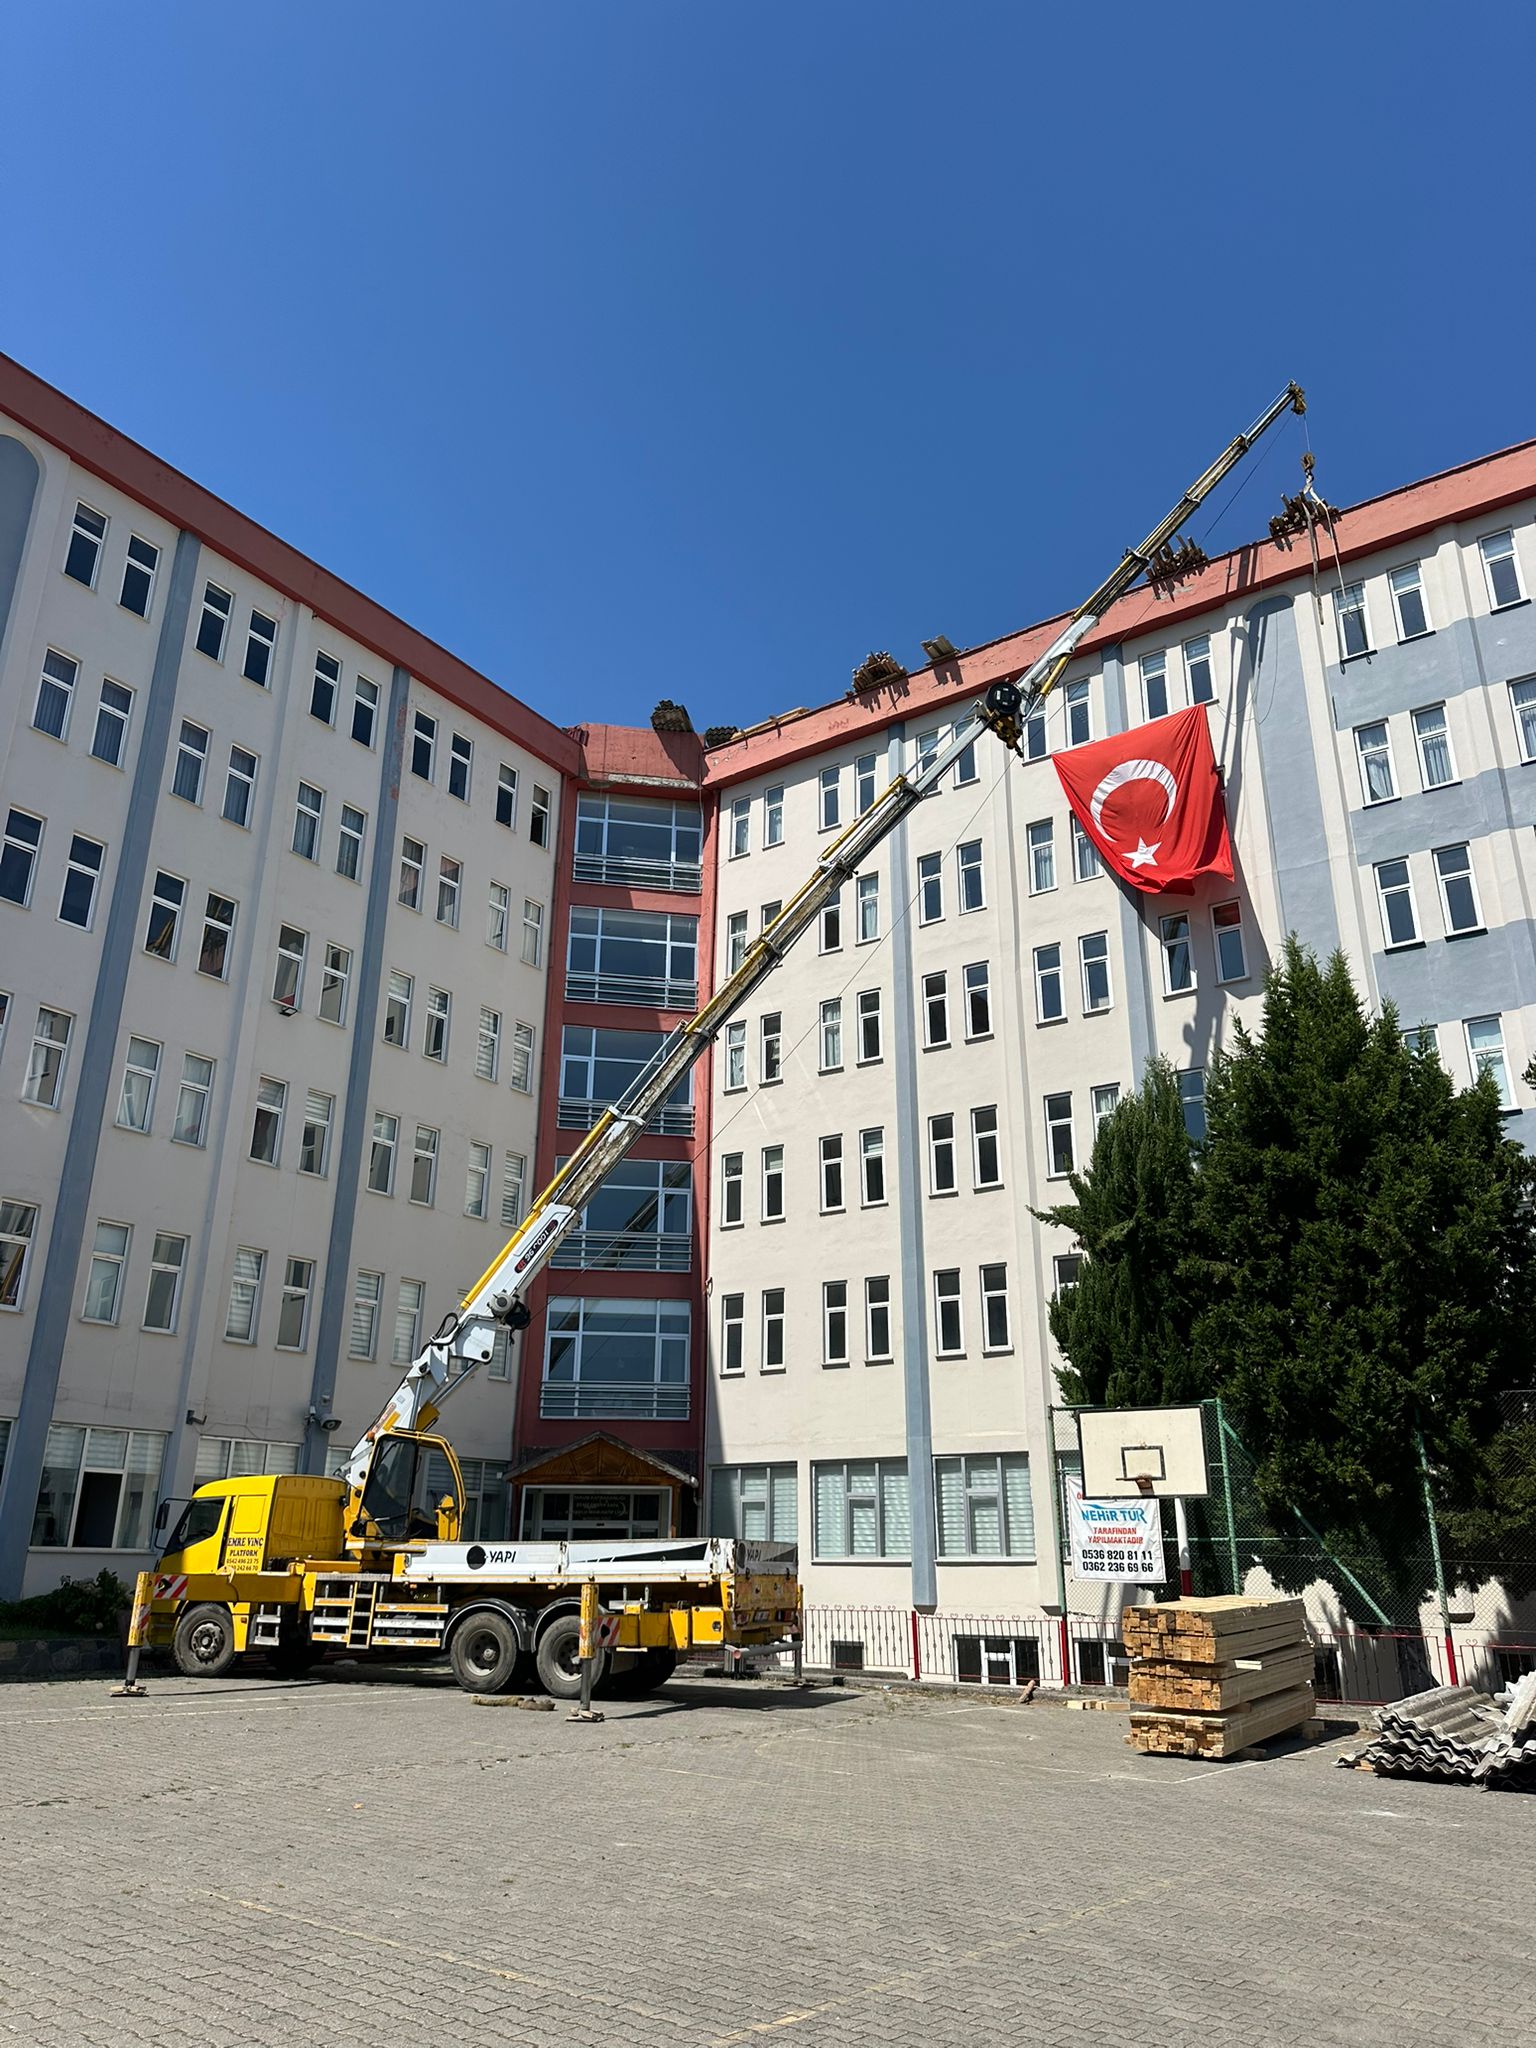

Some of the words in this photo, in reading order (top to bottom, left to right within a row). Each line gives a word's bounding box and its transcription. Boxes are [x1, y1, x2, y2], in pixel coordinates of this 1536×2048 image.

[1119, 1508, 1148, 1524] TUR
[1093, 1527, 1137, 1535] TARAFINDAN
[227, 1537, 246, 1547] EMRE
[1088, 1536, 1144, 1545] YAPILMAKTADIR
[489, 1550, 517, 1563] YAPI
[747, 1549, 762, 1561] YAPI
[1082, 1549, 1105, 1560] 0536
[1107, 1550, 1125, 1560] 820
[1127, 1550, 1138, 1561] 81
[1141, 1550, 1153, 1561] 11
[1082, 1561, 1105, 1572] 0362
[1107, 1562, 1125, 1572] 236
[1127, 1562, 1139, 1573] 69
[1141, 1562, 1154, 1573] 66
